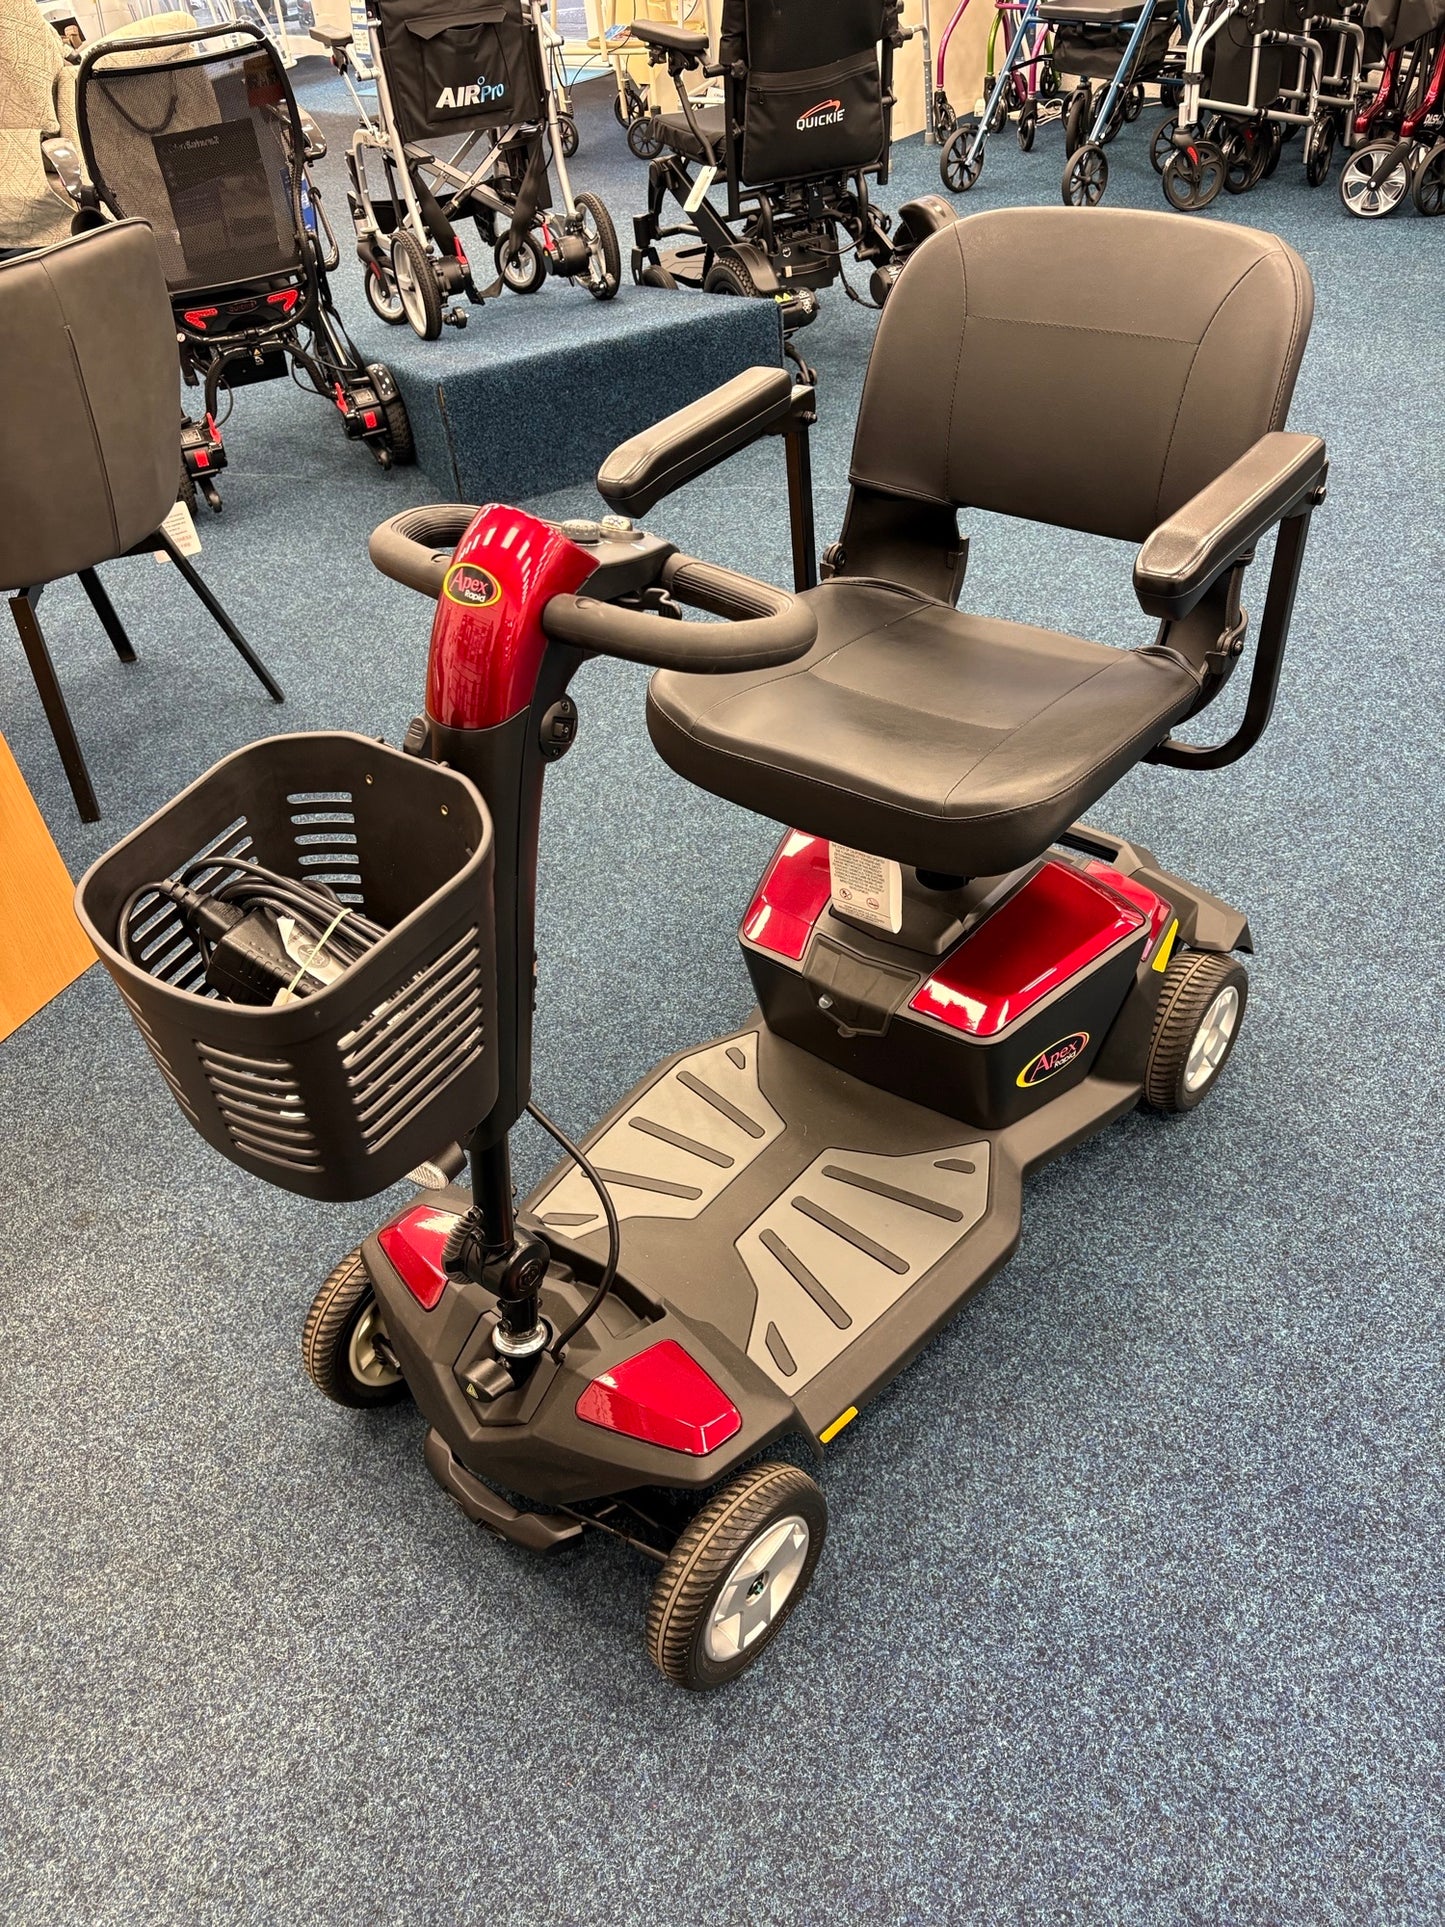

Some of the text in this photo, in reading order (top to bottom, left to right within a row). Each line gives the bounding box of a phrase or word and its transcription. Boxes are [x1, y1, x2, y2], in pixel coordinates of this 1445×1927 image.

[796, 108, 846, 131] QUICKIE
[448, 567, 489, 595] Apex
[464, 589, 487, 603] Rapid
[1029, 1040, 1078, 1083] Apex
[1054, 1050, 1077, 1069] Rapid
